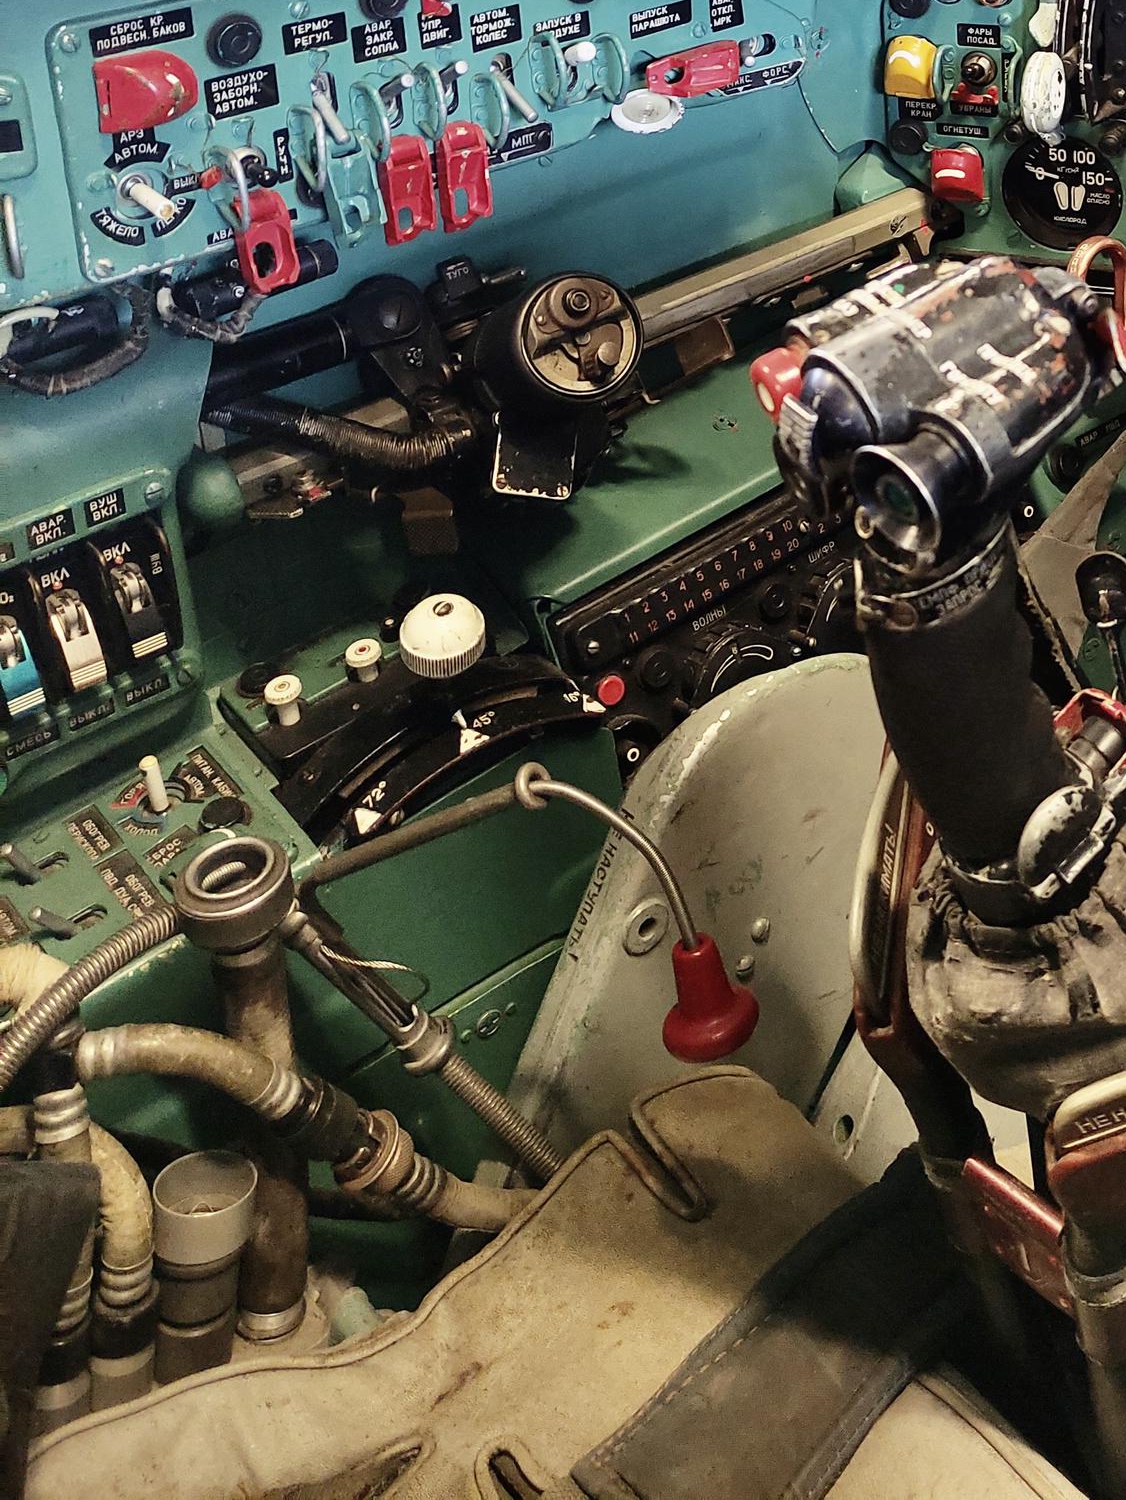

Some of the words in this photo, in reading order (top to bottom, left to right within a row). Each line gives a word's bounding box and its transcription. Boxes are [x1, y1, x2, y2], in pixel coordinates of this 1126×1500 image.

[473, 8, 509, 24] АВТОМ.
[632, 6, 668, 21] ВЫПУСК
[714, 16, 731, 26] МРК
[110, 19, 144, 34] СБРОС
[291, 20, 334, 35] ТЕРМО-
[535, 16, 572, 32] ЗАПУСК
[631, 15, 681, 33] ПАРАШЮТА
[968, 28, 993, 36] ФАРЫ
[97, 31, 150, 51] ПОДВЕСН.
[153, 22, 186, 38] БАКОВ
[294, 32, 333, 48] РЕГУЛ.
[422, 30, 452, 44] ДВИГ.
[476, 30, 508, 46] КОЛЕС
[365, 42, 399, 56] СОПЛА
[763, 66, 790, 78] ФОРС
[212, 70, 268, 92] ВОЗДУХО-
[214, 84, 261, 102] ЗАБОРН.
[215, 97, 257, 114] АВТОМ.
[911, 110, 931, 118] КРАН
[1049, 149, 1067, 162] 50
[1073, 150, 1095, 165] 100
[1083, 172, 1105, 185] 150
[96, 210, 139, 238] ТЯЖЕЛО
[90, 494, 117, 511] ВУШ
[103, 542, 131, 562] ВКЛ
[808, 542, 835, 564] ШИФР
[41, 567, 71, 589] ВКЛ
[693, 606, 727, 632] ВОЛНЫ
